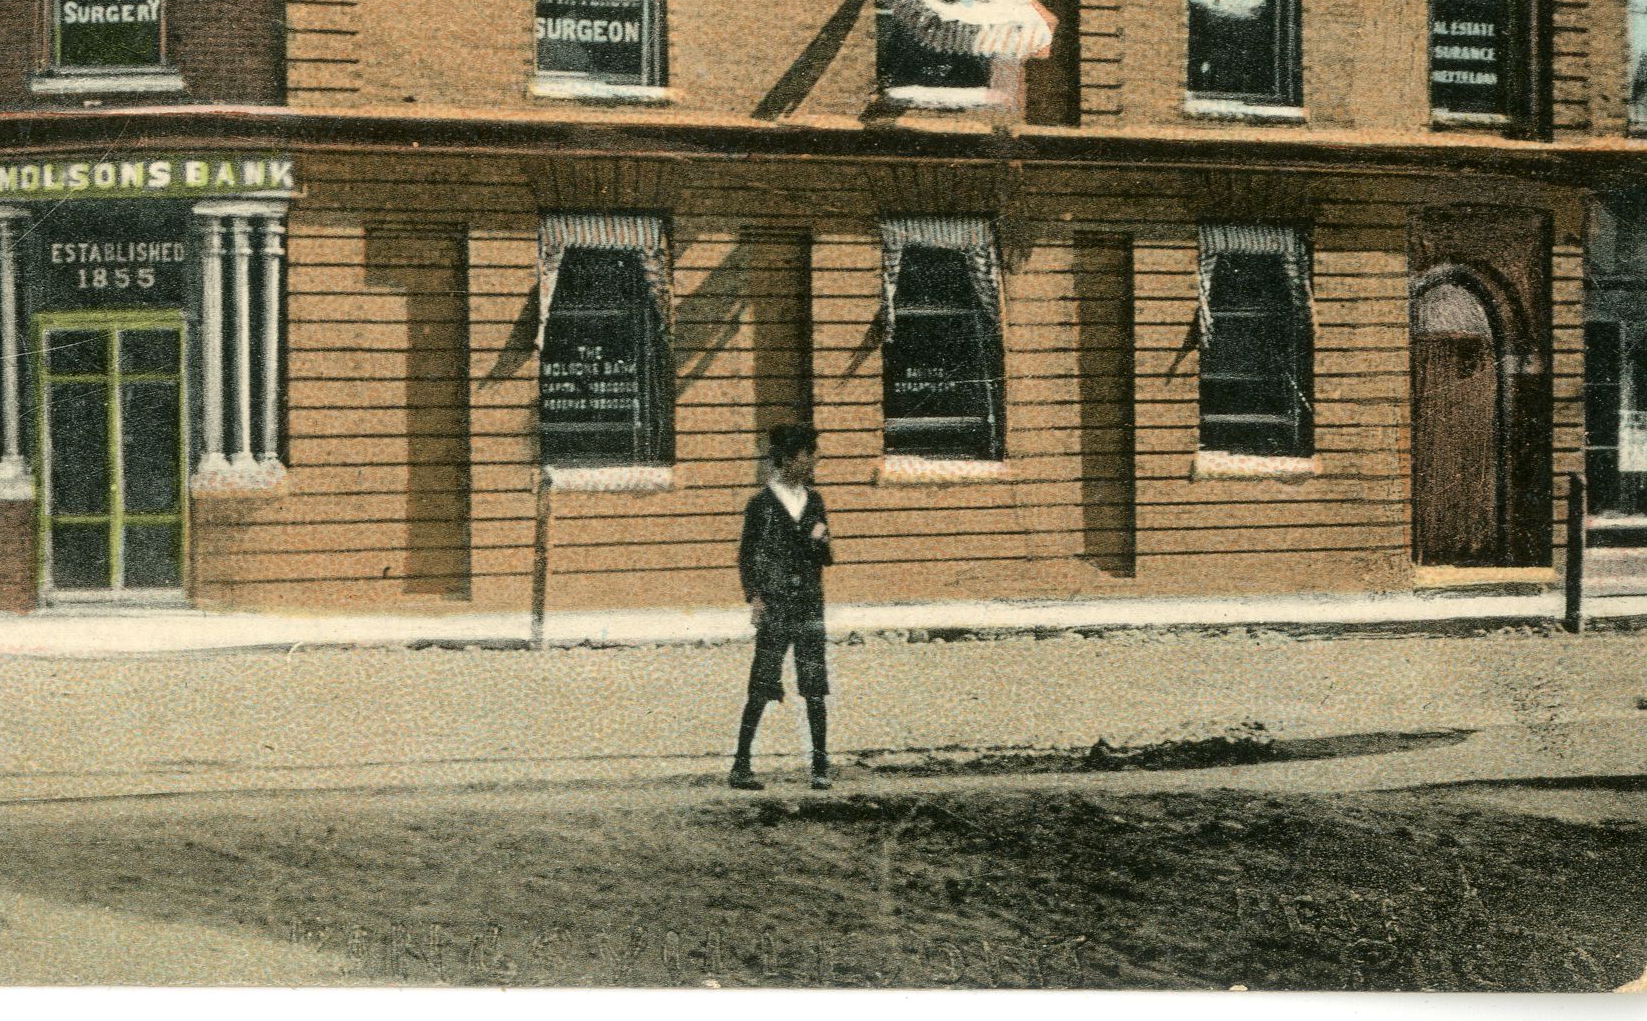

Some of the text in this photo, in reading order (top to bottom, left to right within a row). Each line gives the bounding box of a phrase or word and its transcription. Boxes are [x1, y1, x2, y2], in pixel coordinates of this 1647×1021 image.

[536, 17, 640, 43] SURGEON
[185, 160, 295, 189] BANK
[51, 241, 186, 263] ESTABLISHED
[78, 267, 156, 289] 1855
